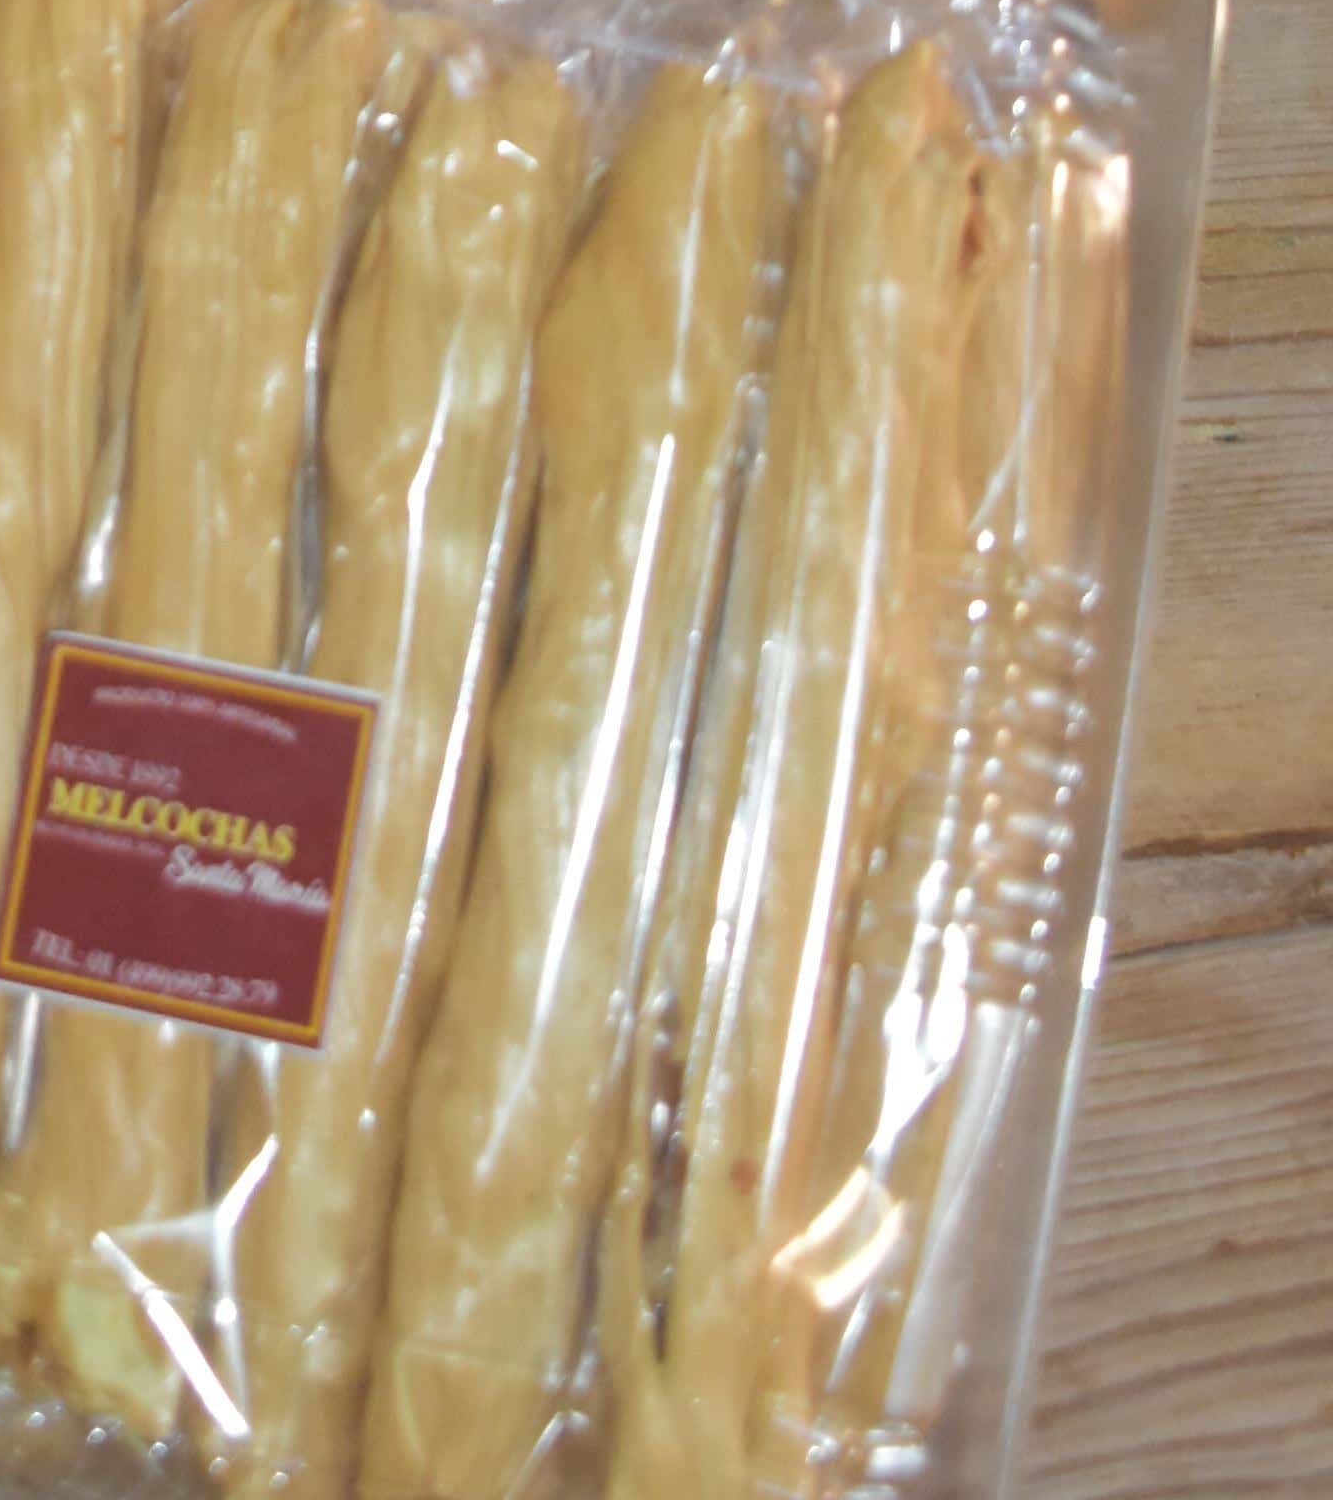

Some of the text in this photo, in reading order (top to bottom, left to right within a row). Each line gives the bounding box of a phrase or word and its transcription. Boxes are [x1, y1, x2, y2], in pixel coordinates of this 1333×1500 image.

[50, 740, 126, 781] DESDE
[47, 776, 295, 863] MELCOCHAS
[161, 844, 245, 896] Santa
